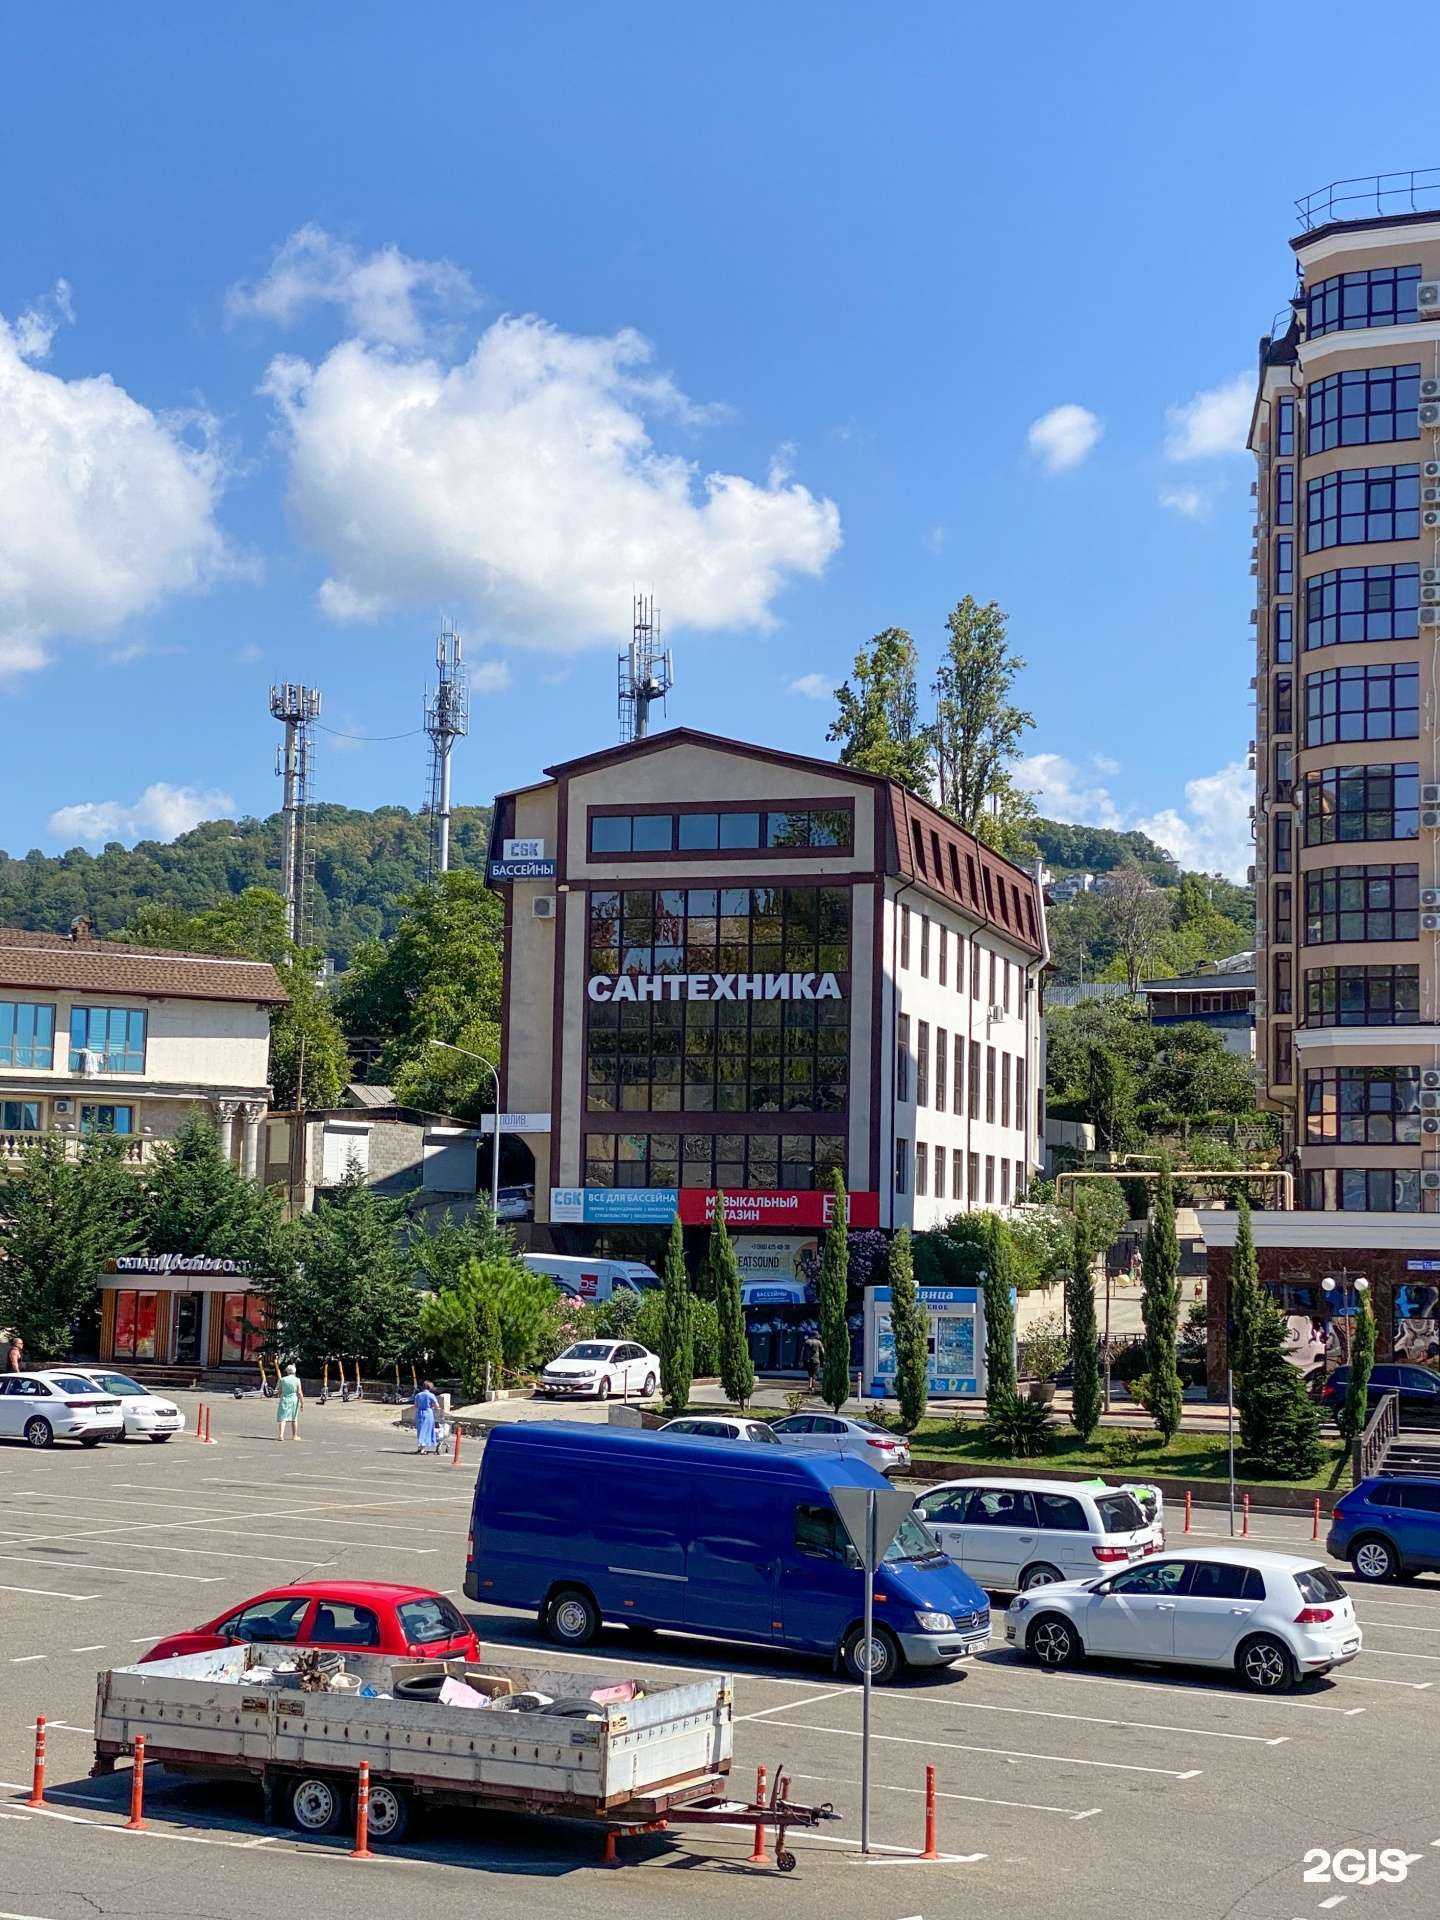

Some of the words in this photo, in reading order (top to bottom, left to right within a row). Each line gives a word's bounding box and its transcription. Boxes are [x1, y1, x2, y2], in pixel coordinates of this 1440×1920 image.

[492, 861, 554, 876] БАССЕЙНЫ
[587, 972, 843, 1002] САНТЕХНИКА
[588, 1193, 605, 1203] ВСЕ
[606, 1193, 626, 1204] ДЛЯ
[627, 1192, 677, 1203] БАССЕЙНА
[705, 1196, 799, 1209] МЗЫКАЛЬНЫЙ
[705, 1209, 760, 1221] МГАЗИН
[116, 1256, 158, 1272] СКЛАД
[157, 1253, 222, 1277] Цветы
[738, 1255, 779, 1269] EATSOUND
[914, 1290, 954, 1300] авица
